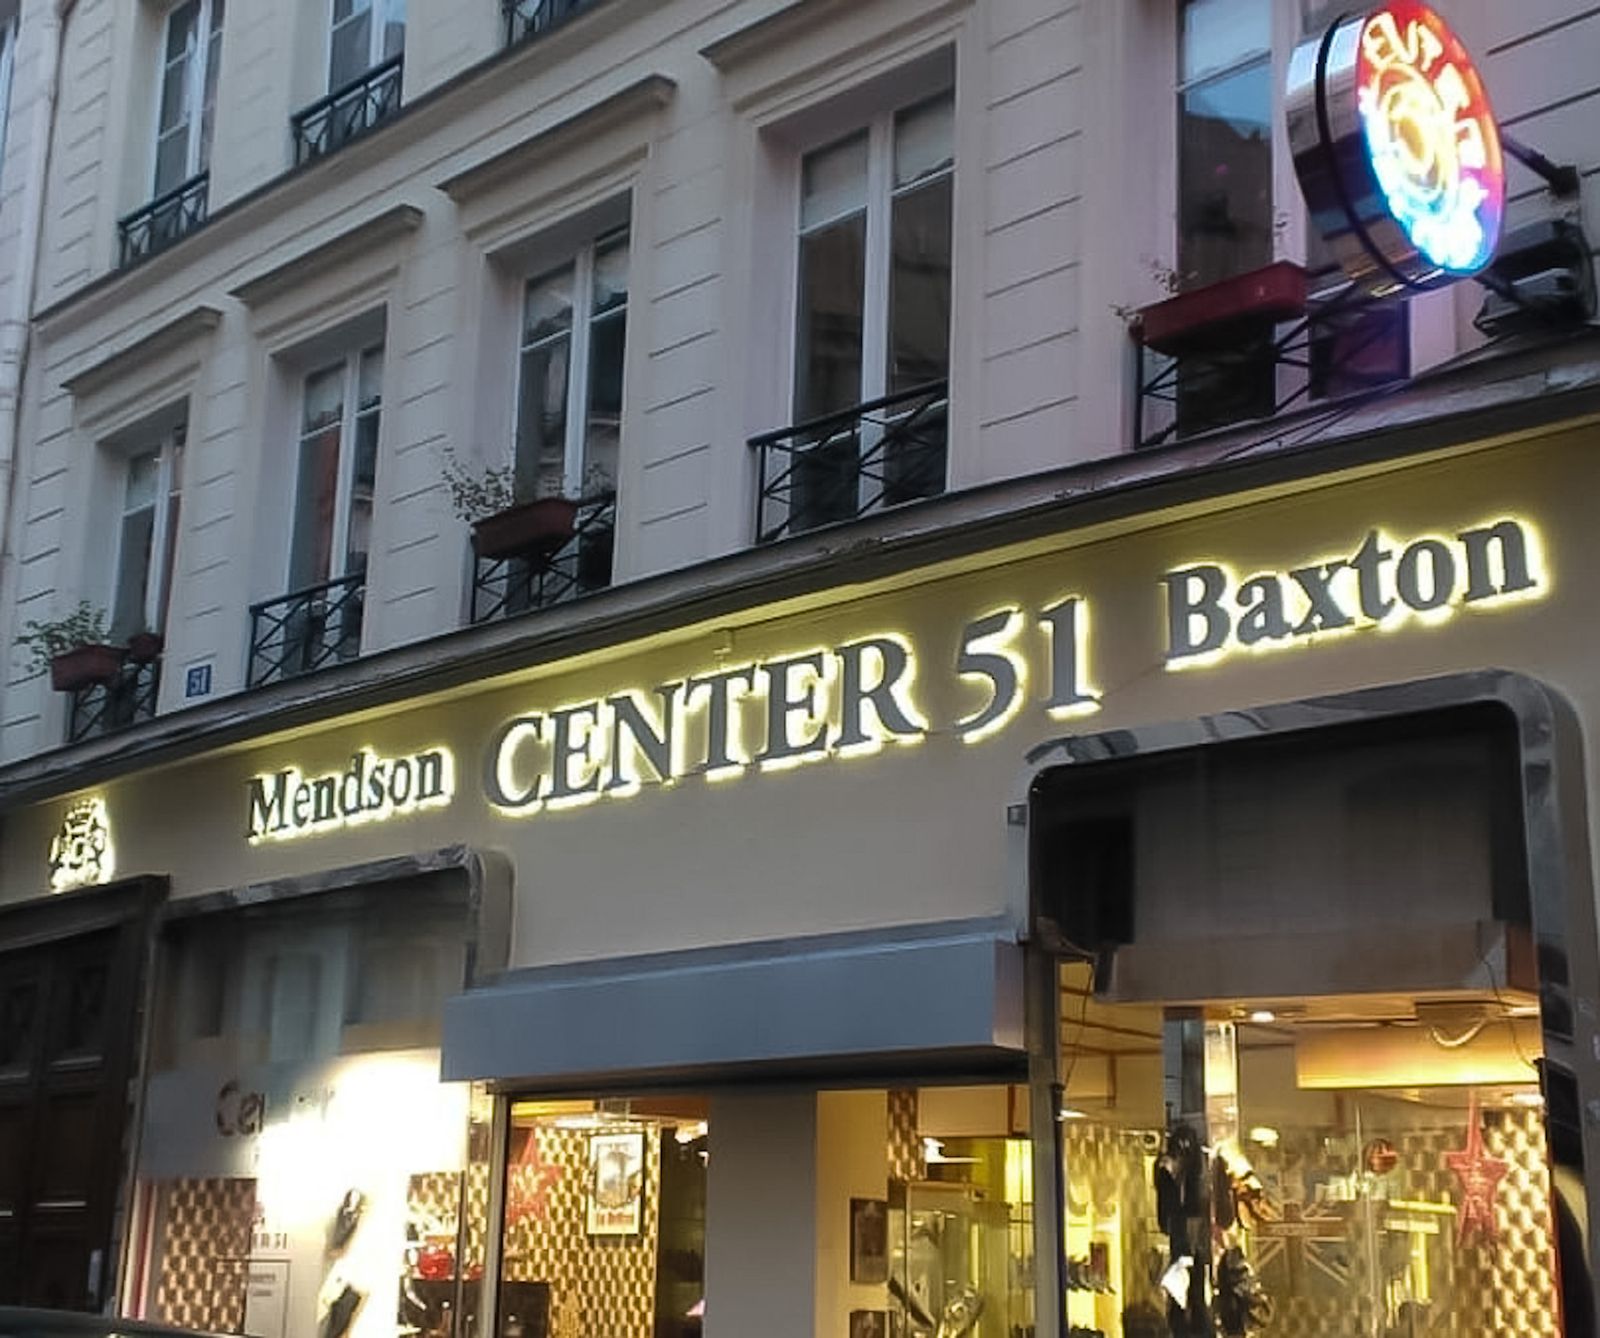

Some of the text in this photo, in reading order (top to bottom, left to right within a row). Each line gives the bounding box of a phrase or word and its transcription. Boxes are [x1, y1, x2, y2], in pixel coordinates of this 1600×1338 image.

[191, 668, 207, 694] 51
[246, 519, 1537, 838] Mendson CENTER 51 Baxton
